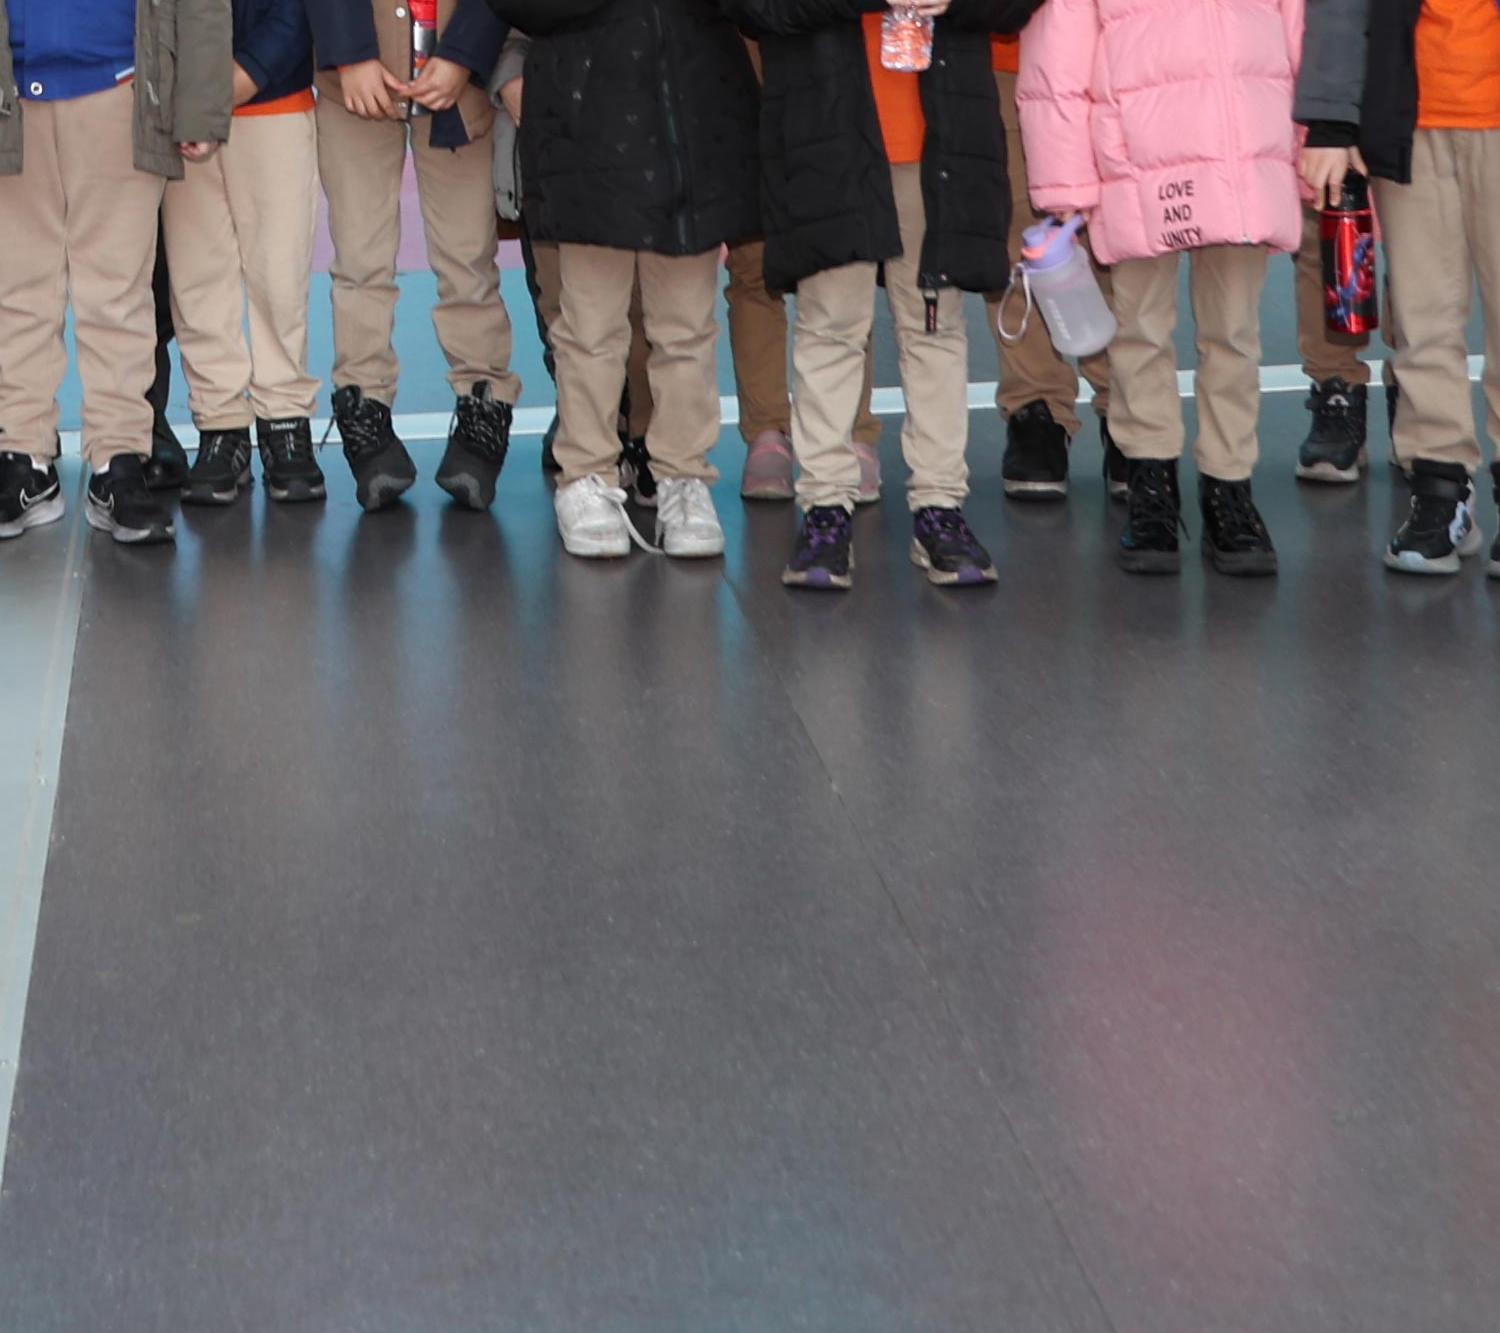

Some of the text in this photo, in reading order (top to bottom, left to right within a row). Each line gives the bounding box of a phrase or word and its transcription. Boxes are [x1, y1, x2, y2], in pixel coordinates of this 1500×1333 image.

[1158, 180, 1194, 201] LOVE
[1163, 204, 1192, 224] AND
[1160, 225, 1203, 249] UNITY
